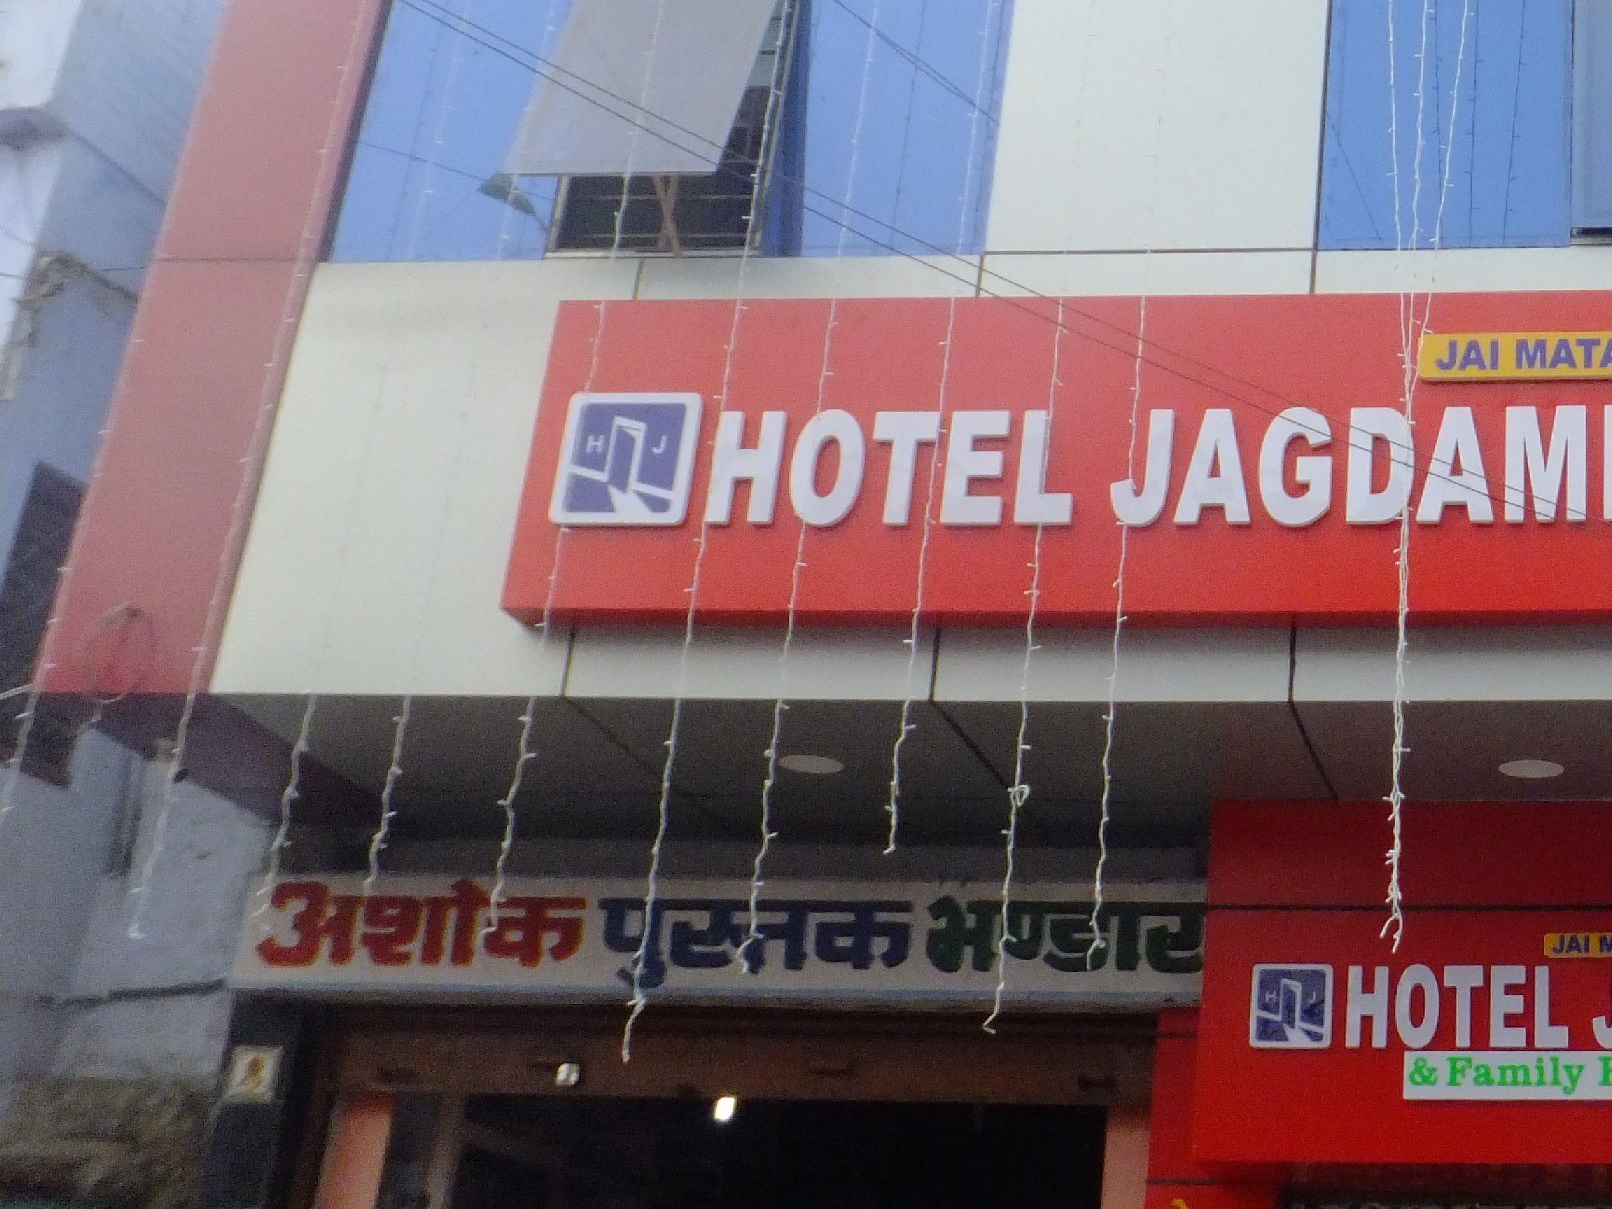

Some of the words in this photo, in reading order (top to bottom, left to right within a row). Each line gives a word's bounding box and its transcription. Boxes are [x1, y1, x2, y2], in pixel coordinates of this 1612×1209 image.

[1434, 339, 1500, 371] JAI
[586, 434, 605, 453] H
[651, 435, 667, 454] J
[703, 408, 1075, 528] HOTEL
[257, 879, 588, 968] अशोक
[600, 897, 913, 990] पुस्तक
[924, 895, 1204, 973] भण्डार
[1552, 933, 1591, 953] JAI
[1344, 964, 1569, 1048] HOTEL
[1408, 1060, 1438, 1087] &
[1447, 1056, 1585, 1096] Family
